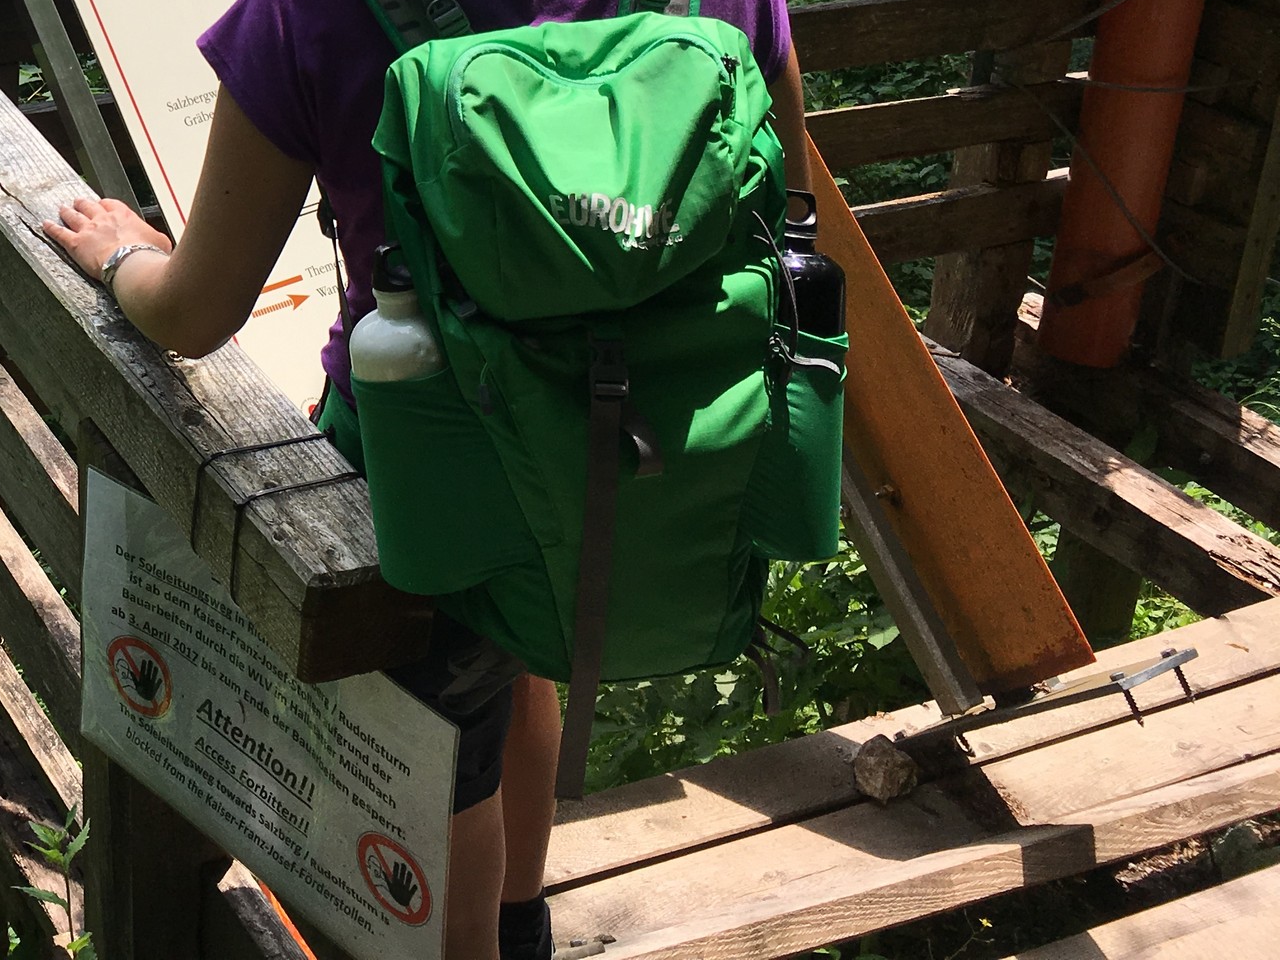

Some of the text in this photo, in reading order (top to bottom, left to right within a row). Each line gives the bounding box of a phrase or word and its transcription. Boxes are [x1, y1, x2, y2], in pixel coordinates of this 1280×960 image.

[166, 90, 218, 112] Salzbergw
[184, 111, 214, 126] Gräbe
[115, 544, 245, 627] Der Soleleitungsweg in
[111, 606, 125, 619] ab
[128, 613, 139, 626] 3.
[142, 620, 170, 644] April
[172, 637, 199, 663] 2017
[201, 657, 216, 676] bis
[219, 672, 241, 695] zum
[243, 690, 270, 718] Ende
[272, 714, 290, 734] der
[292, 730, 350, 796] Bauarbeiten
[122, 588, 193, 634] Bauarbeiten
[196, 629, 227, 657] durch
[229, 652, 246, 672] die
[248, 666, 272, 690] WLV
[274, 686, 288, 706] im
[339, 754, 397, 809] Mühlbach
[129, 571, 143, 588] ist
[145, 582, 160, 596] ab
[164, 590, 190, 611] dem
[372, 761, 393, 784] der
[126, 727, 162, 763] blocked
[162, 758, 186, 784] from
[187, 778, 204, 798] the
[195, 736, 310, 836] Access Forbitten!!
[196, 698, 315, 806] Attention!!
[338, 710, 411, 777] Rudolfsturm
[120, 702, 136, 723] The
[138, 717, 214, 786] Soleleitungsweg
[216, 779, 257, 819] towards
[259, 814, 303, 857] Salzberg
[310, 857, 378, 916] Rudolfsturm
[381, 912, 390, 925] is
